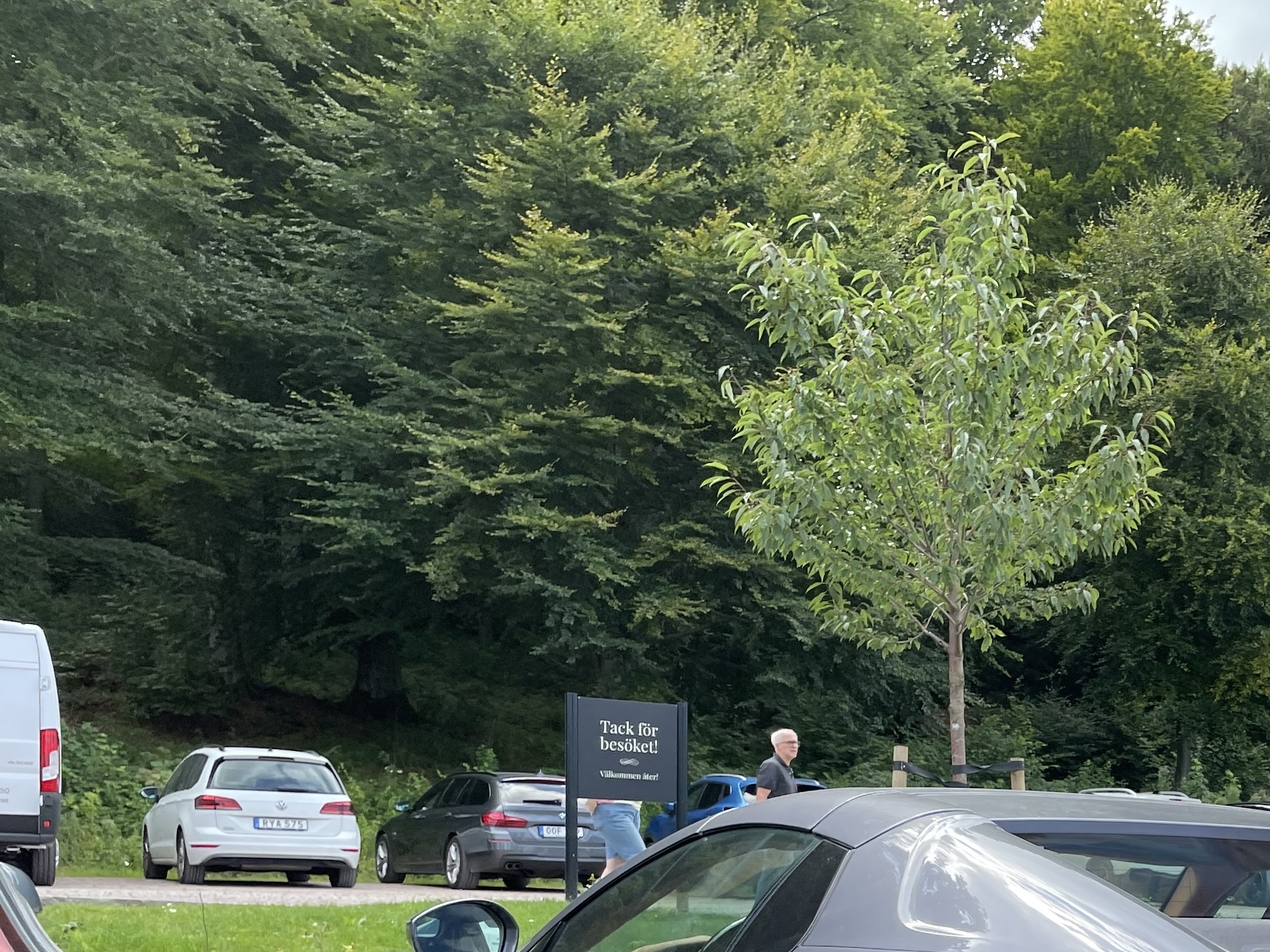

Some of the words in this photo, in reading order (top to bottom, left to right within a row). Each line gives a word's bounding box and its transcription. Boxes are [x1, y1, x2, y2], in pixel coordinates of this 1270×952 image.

[600, 720, 634, 735] Tack
[638, 722, 659, 737] för
[600, 736, 658, 754] besöket!
[599, 770, 641, 780] Välkommen
[262, 819, 282, 828] RYA
[284, 820, 304, 828] 575
